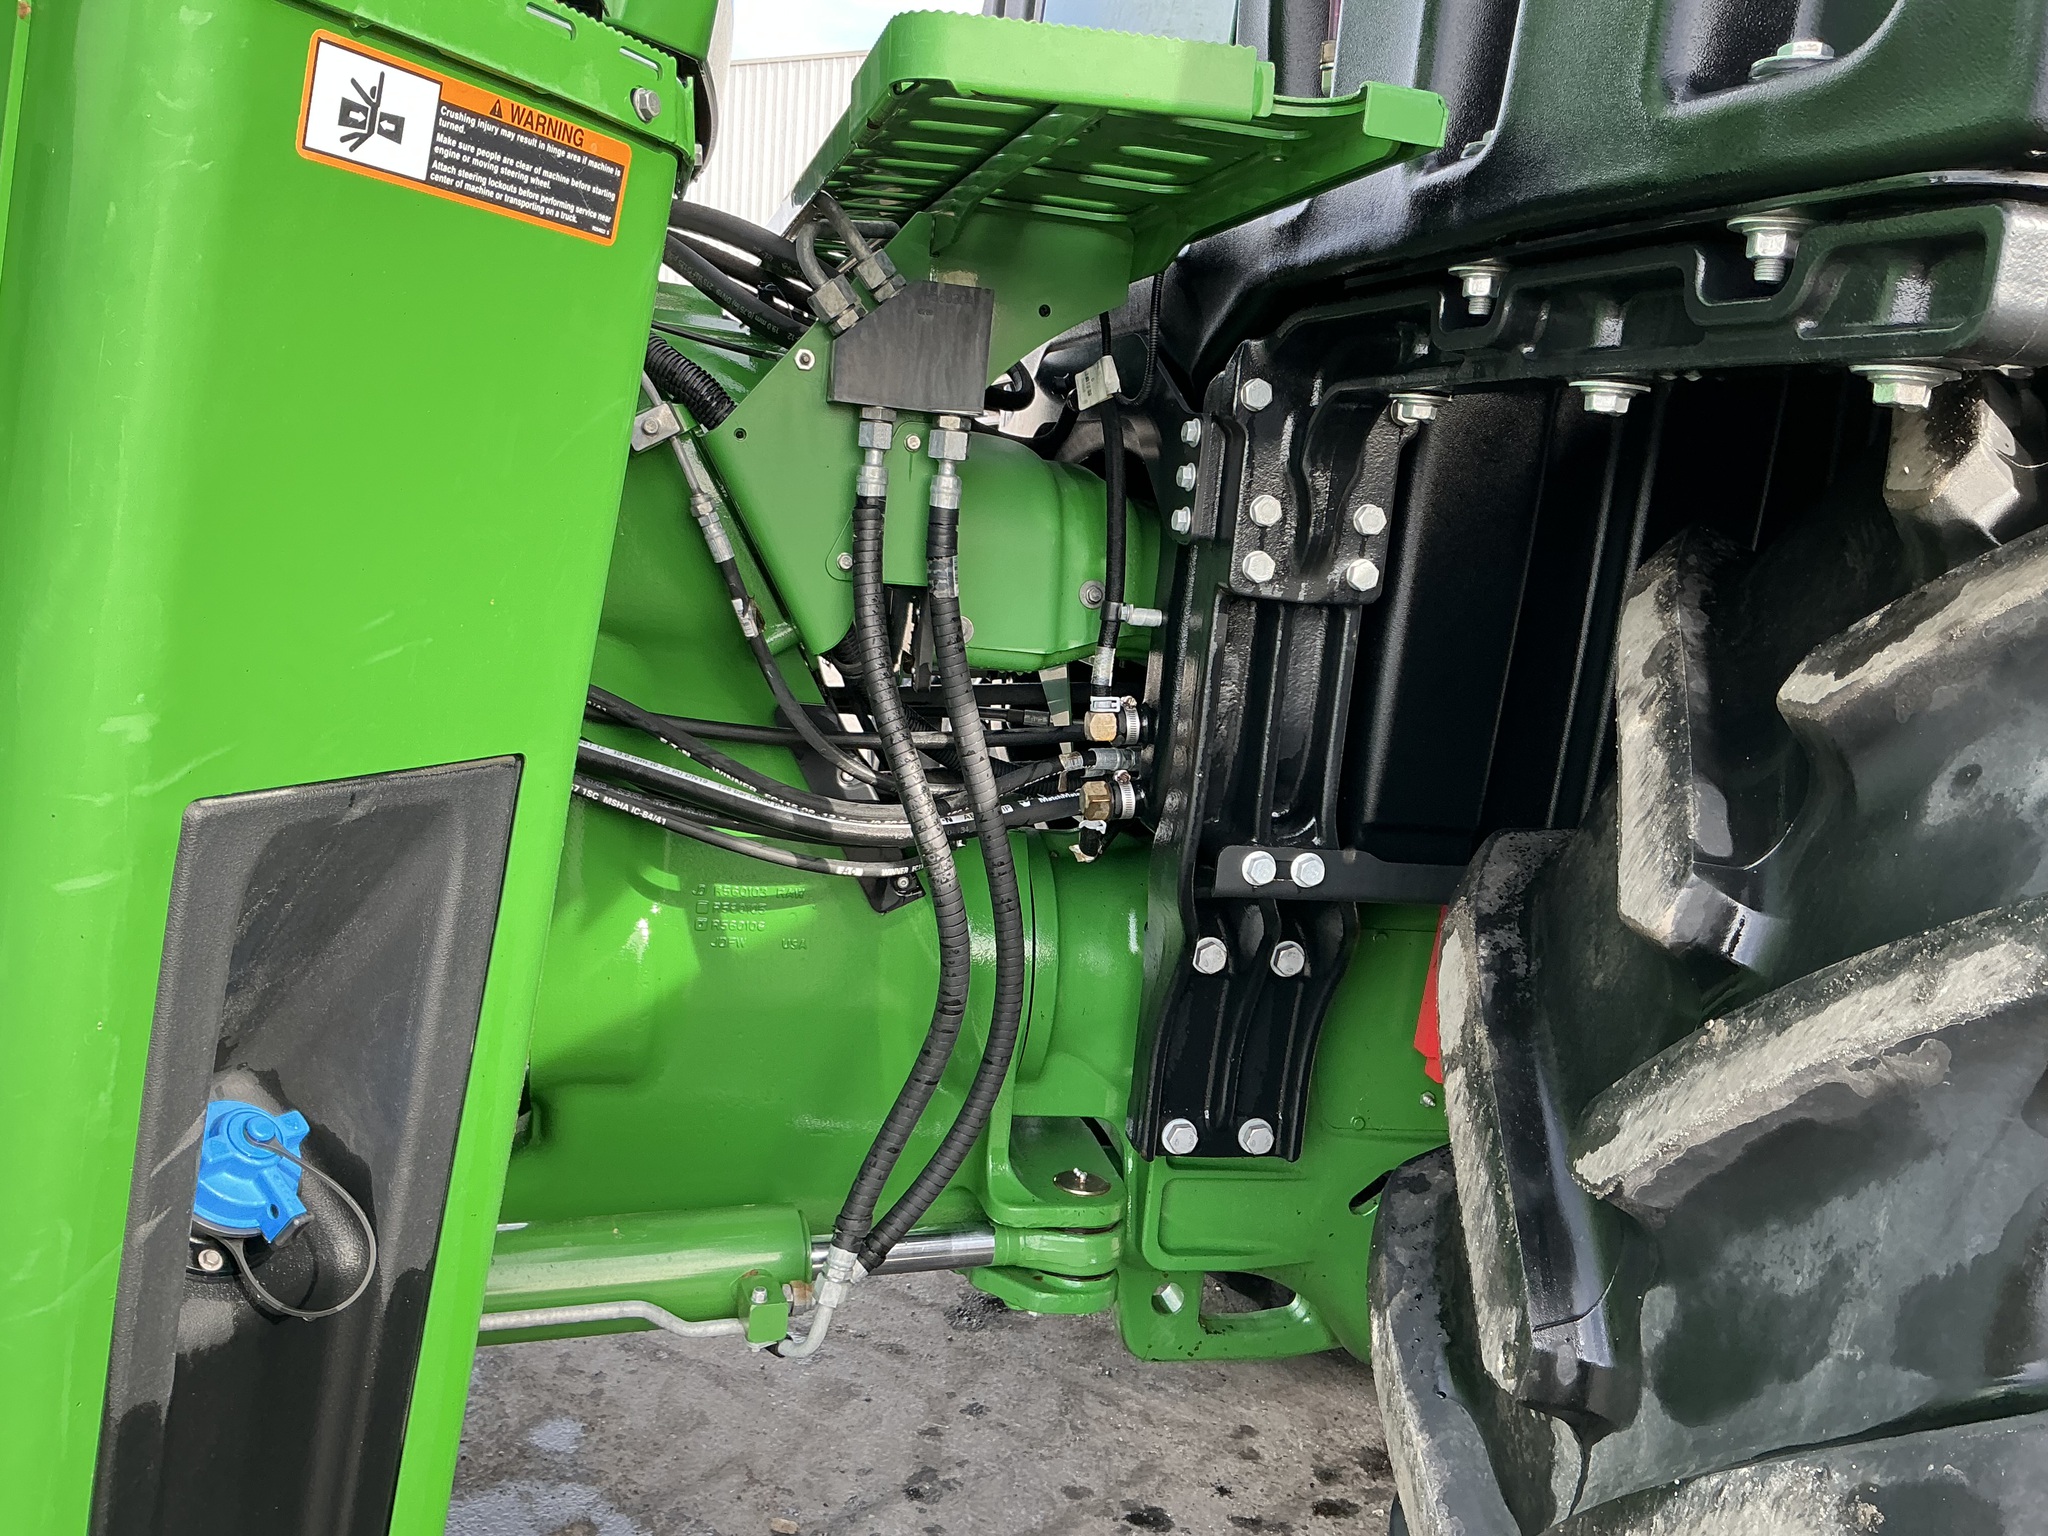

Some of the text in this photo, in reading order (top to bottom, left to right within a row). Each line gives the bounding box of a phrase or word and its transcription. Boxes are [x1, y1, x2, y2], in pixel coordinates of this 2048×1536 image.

[438, 117, 465, 134] turned.
[440, 105, 620, 176] Crushing injury may result in hinge area if machine is
[510, 104, 584, 148] WARNING
[434, 145, 550, 189] engine or moving steering wheel.
[435, 132, 615, 201] Make sure people are clear of machine before starting
[429, 172, 454, 185] center
[454, 179, 463, 188] of
[463, 182, 494, 197] machine
[494, 192, 503, 200] or
[504, 193, 544, 215] transporting
[545, 207, 554, 216] on
[560, 210, 577, 223] truck.
[431, 159, 611, 225] Attach steering lockouts before performing service near
[581, 788, 599, 800] 1SC
[602, 795, 630, 811] MSHA
[630, 806, 667, 825] IC-84/41
[776, 887, 806, 898] RAW
[880, 866, 908, 875] WINNER
[782, 938, 806, 950] USA
